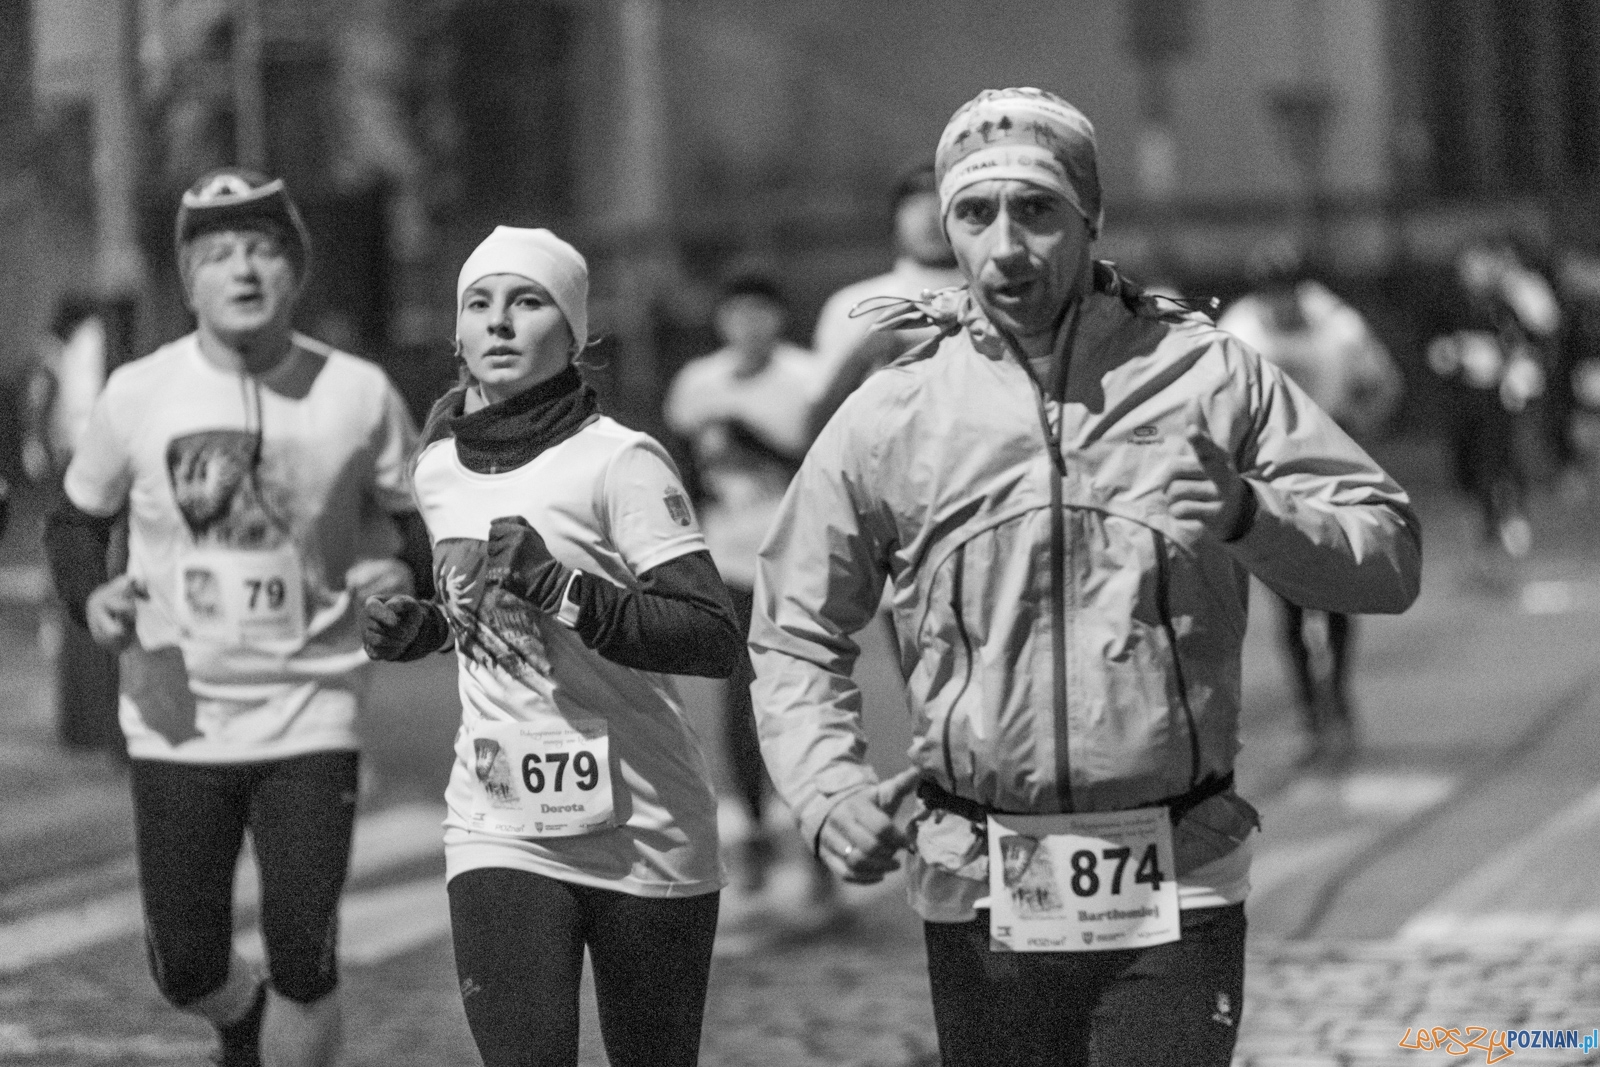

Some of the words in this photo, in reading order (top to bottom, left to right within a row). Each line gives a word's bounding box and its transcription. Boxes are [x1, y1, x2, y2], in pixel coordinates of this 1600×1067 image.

[244, 578, 286, 610] 79
[522, 751, 598, 794] 679
[540, 803, 584, 813] Dorota
[1071, 843, 1164, 897] 874
